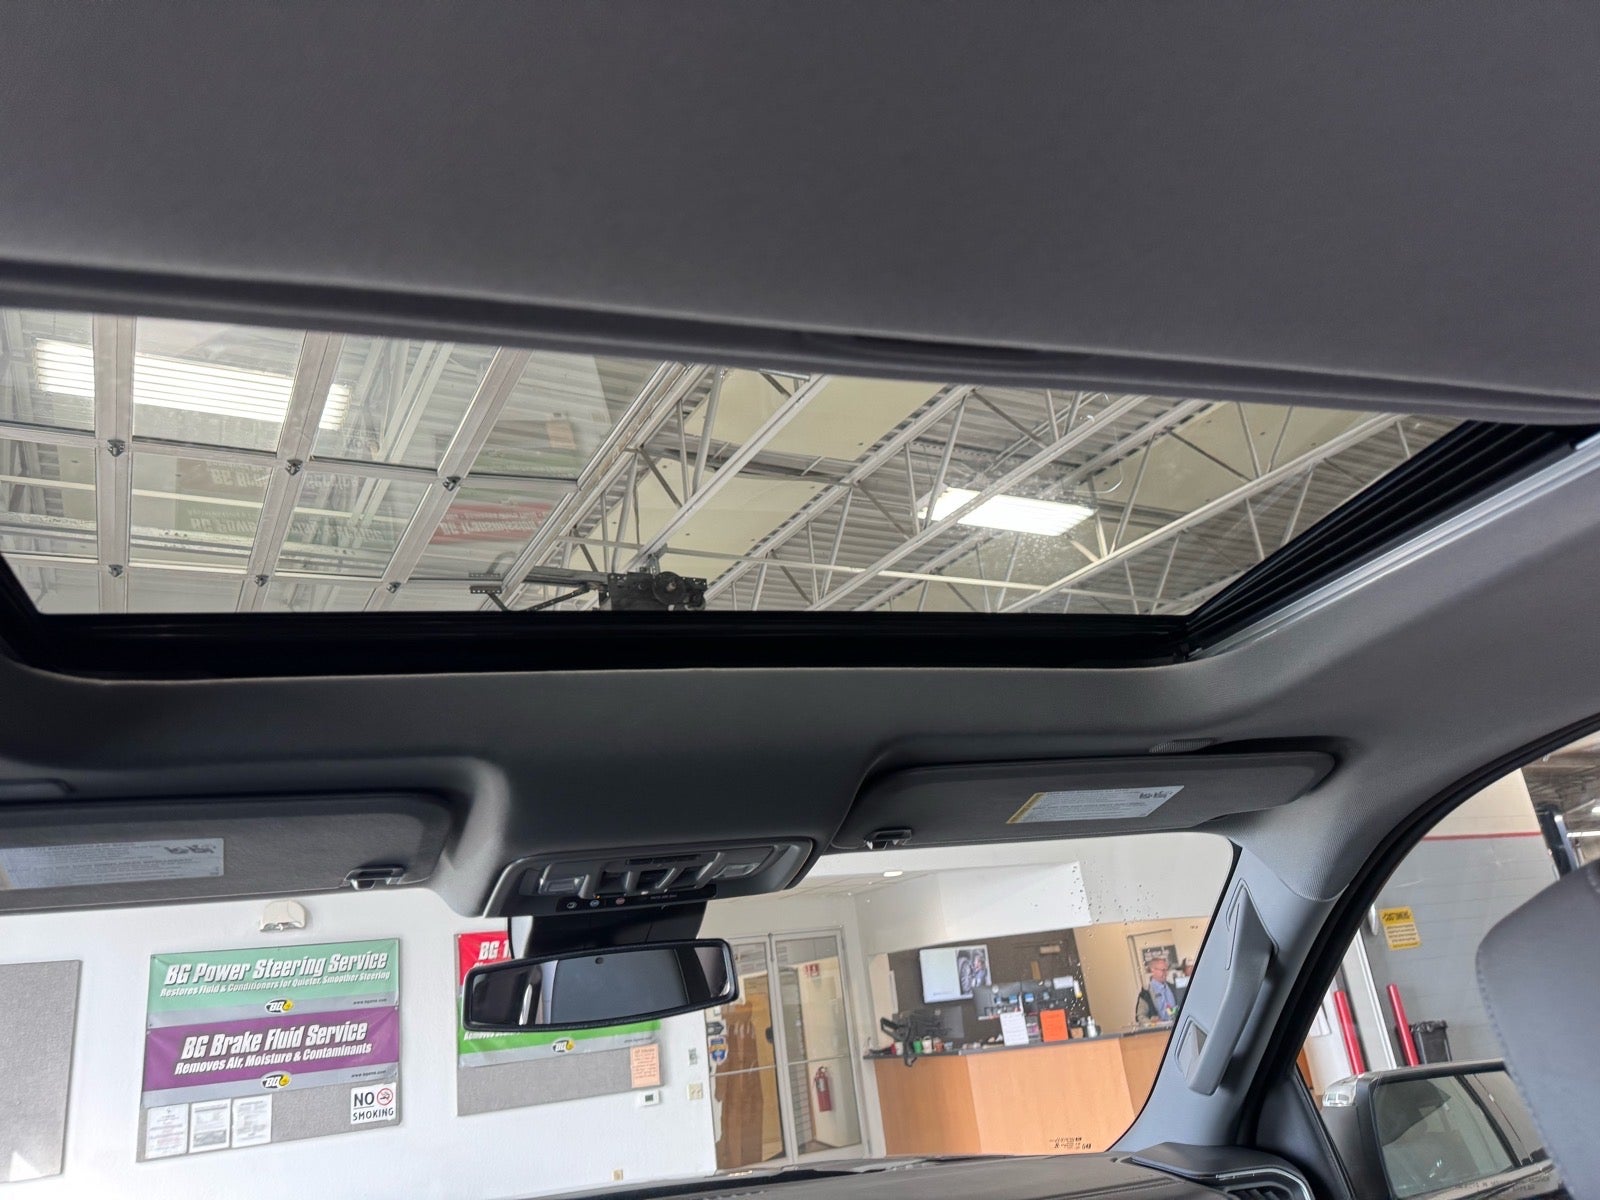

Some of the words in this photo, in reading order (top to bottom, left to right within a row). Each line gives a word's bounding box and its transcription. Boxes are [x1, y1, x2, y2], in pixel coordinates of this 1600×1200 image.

[479, 940, 500, 960] BG
[164, 963, 193, 985] BG
[193, 963, 250, 983] Power
[252, 955, 326, 979] Steering
[328, 951, 388, 973] Service
[160, 986, 199, 997] Restores
[199, 984, 220, 994] Fluid
[181, 1035, 209, 1060] BG
[210, 1029, 262, 1055] Brake
[264, 1025, 305, 1050] Fluid
[306, 1020, 368, 1046] Service
[175, 1058, 227, 1075] Removes
[246, 1051, 294, 1067] Moisture
[293, 1051, 302, 1062] &
[302, 1042, 372, 1061] Contaminants
[353, 1091, 375, 1107] NO
[352, 1108, 394, 1121] SMOKING
